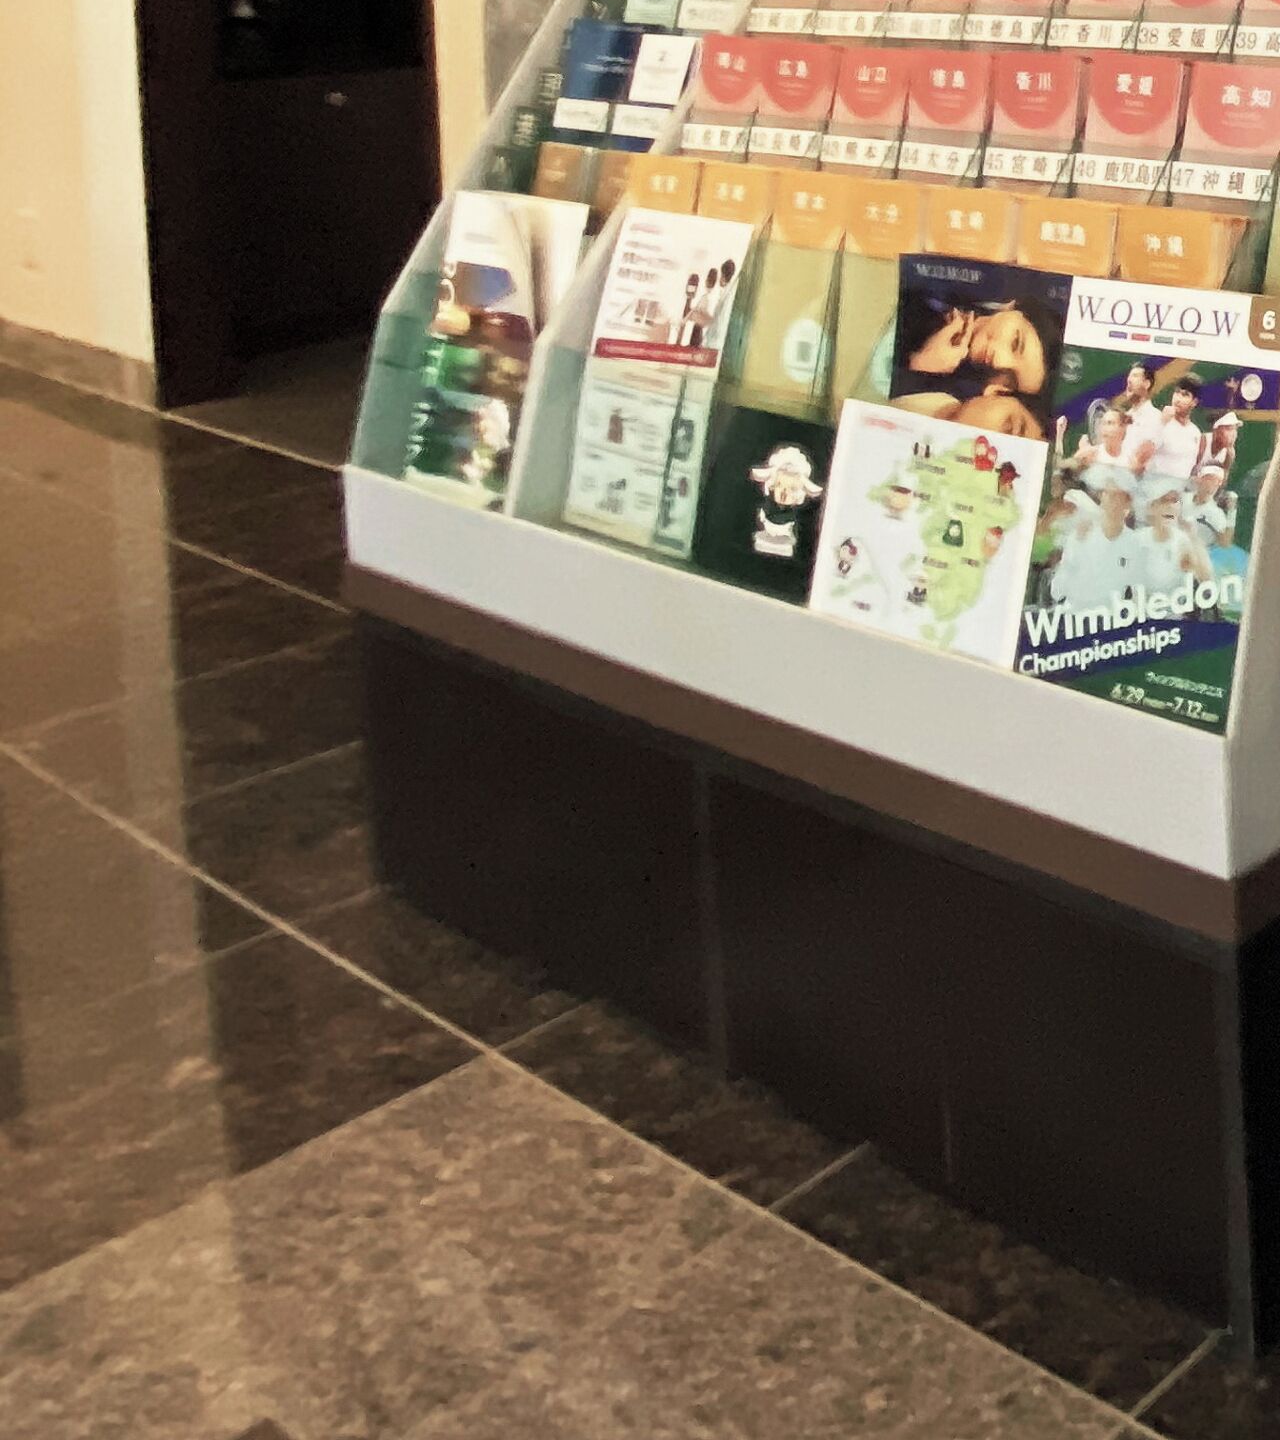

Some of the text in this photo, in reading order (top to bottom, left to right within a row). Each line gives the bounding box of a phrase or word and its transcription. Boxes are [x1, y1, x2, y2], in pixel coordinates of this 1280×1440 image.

[1138, 27, 1159, 44] 38
[1236, 31, 1257, 49] 39
[1016, 71, 1053, 91] 香川
[1116, 73, 1154, 97] 愛媛
[1221, 85, 1273, 109] 高知
[1172, 167, 1194, 187] 47
[1040, 220, 1086, 246] 鹿児島
[1144, 233, 1185, 257] 沖縄
[1077, 294, 1241, 337] WOWOW
[1261, 310, 1277, 331] 6
[1025, 571, 1246, 648] Wimbledon
[1019, 626, 1182, 675] Championships
